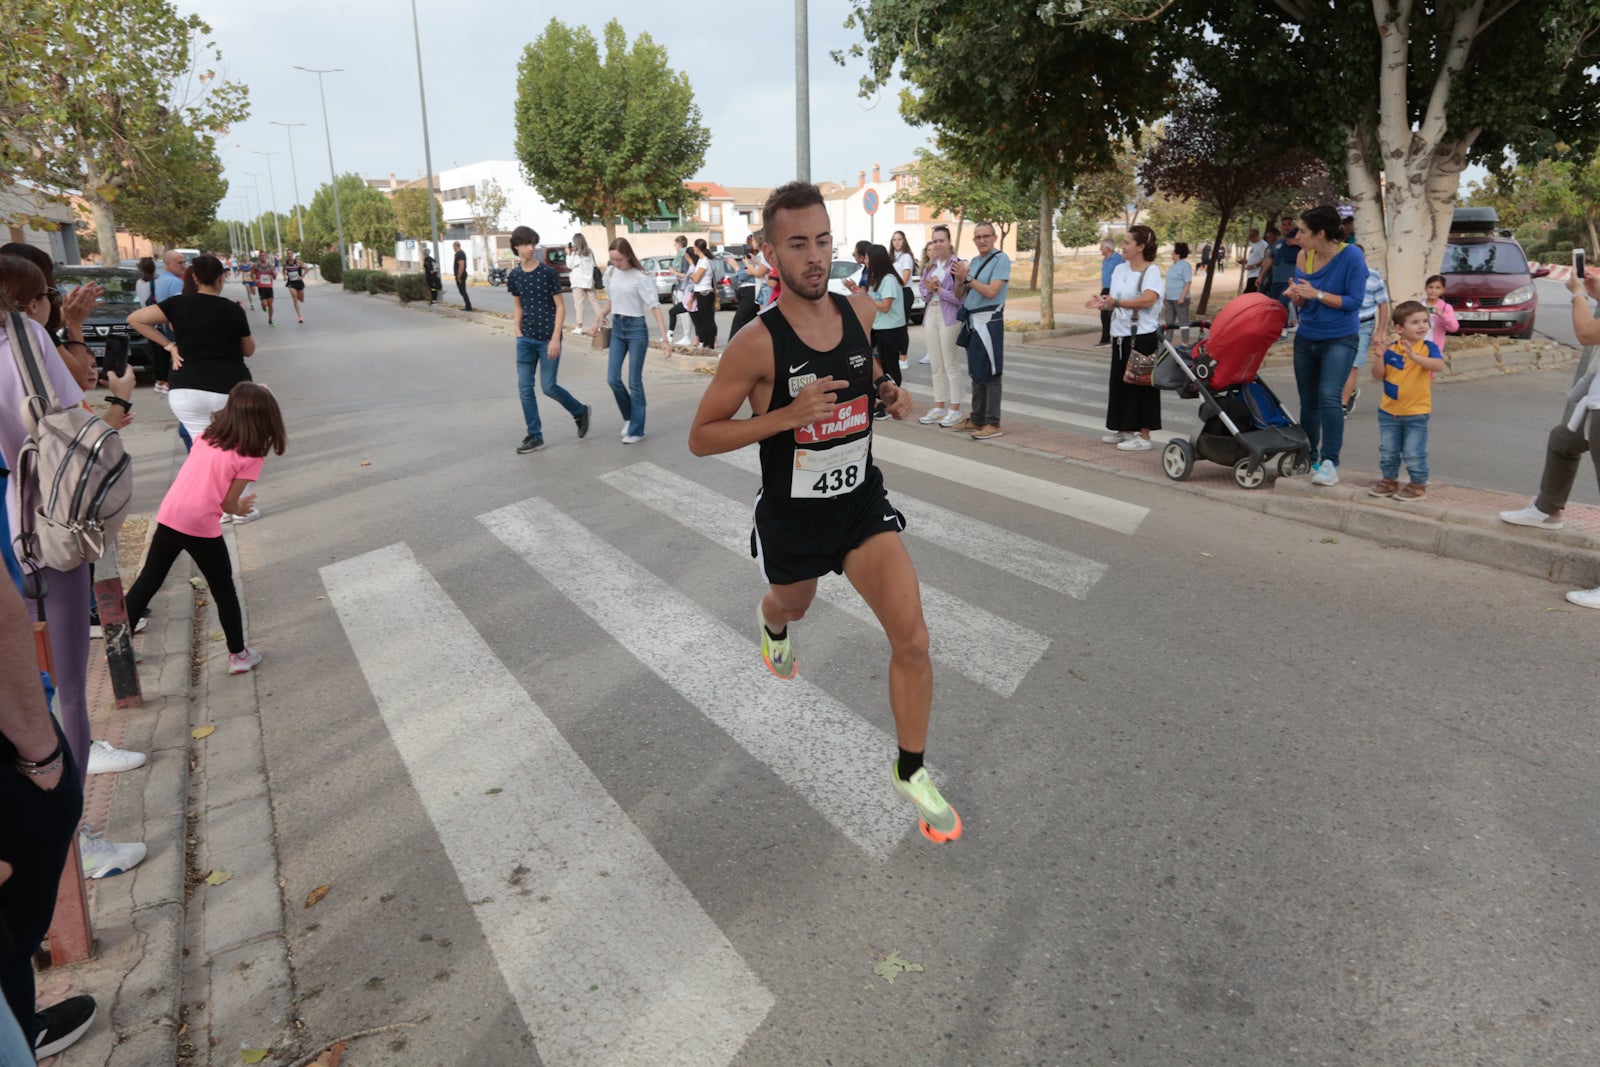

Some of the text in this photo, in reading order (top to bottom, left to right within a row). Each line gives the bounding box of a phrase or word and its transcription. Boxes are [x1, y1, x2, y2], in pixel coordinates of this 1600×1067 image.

[821, 412, 867, 435] TRAINING
[838, 405, 852, 421] GO
[812, 465, 858, 494] 438
